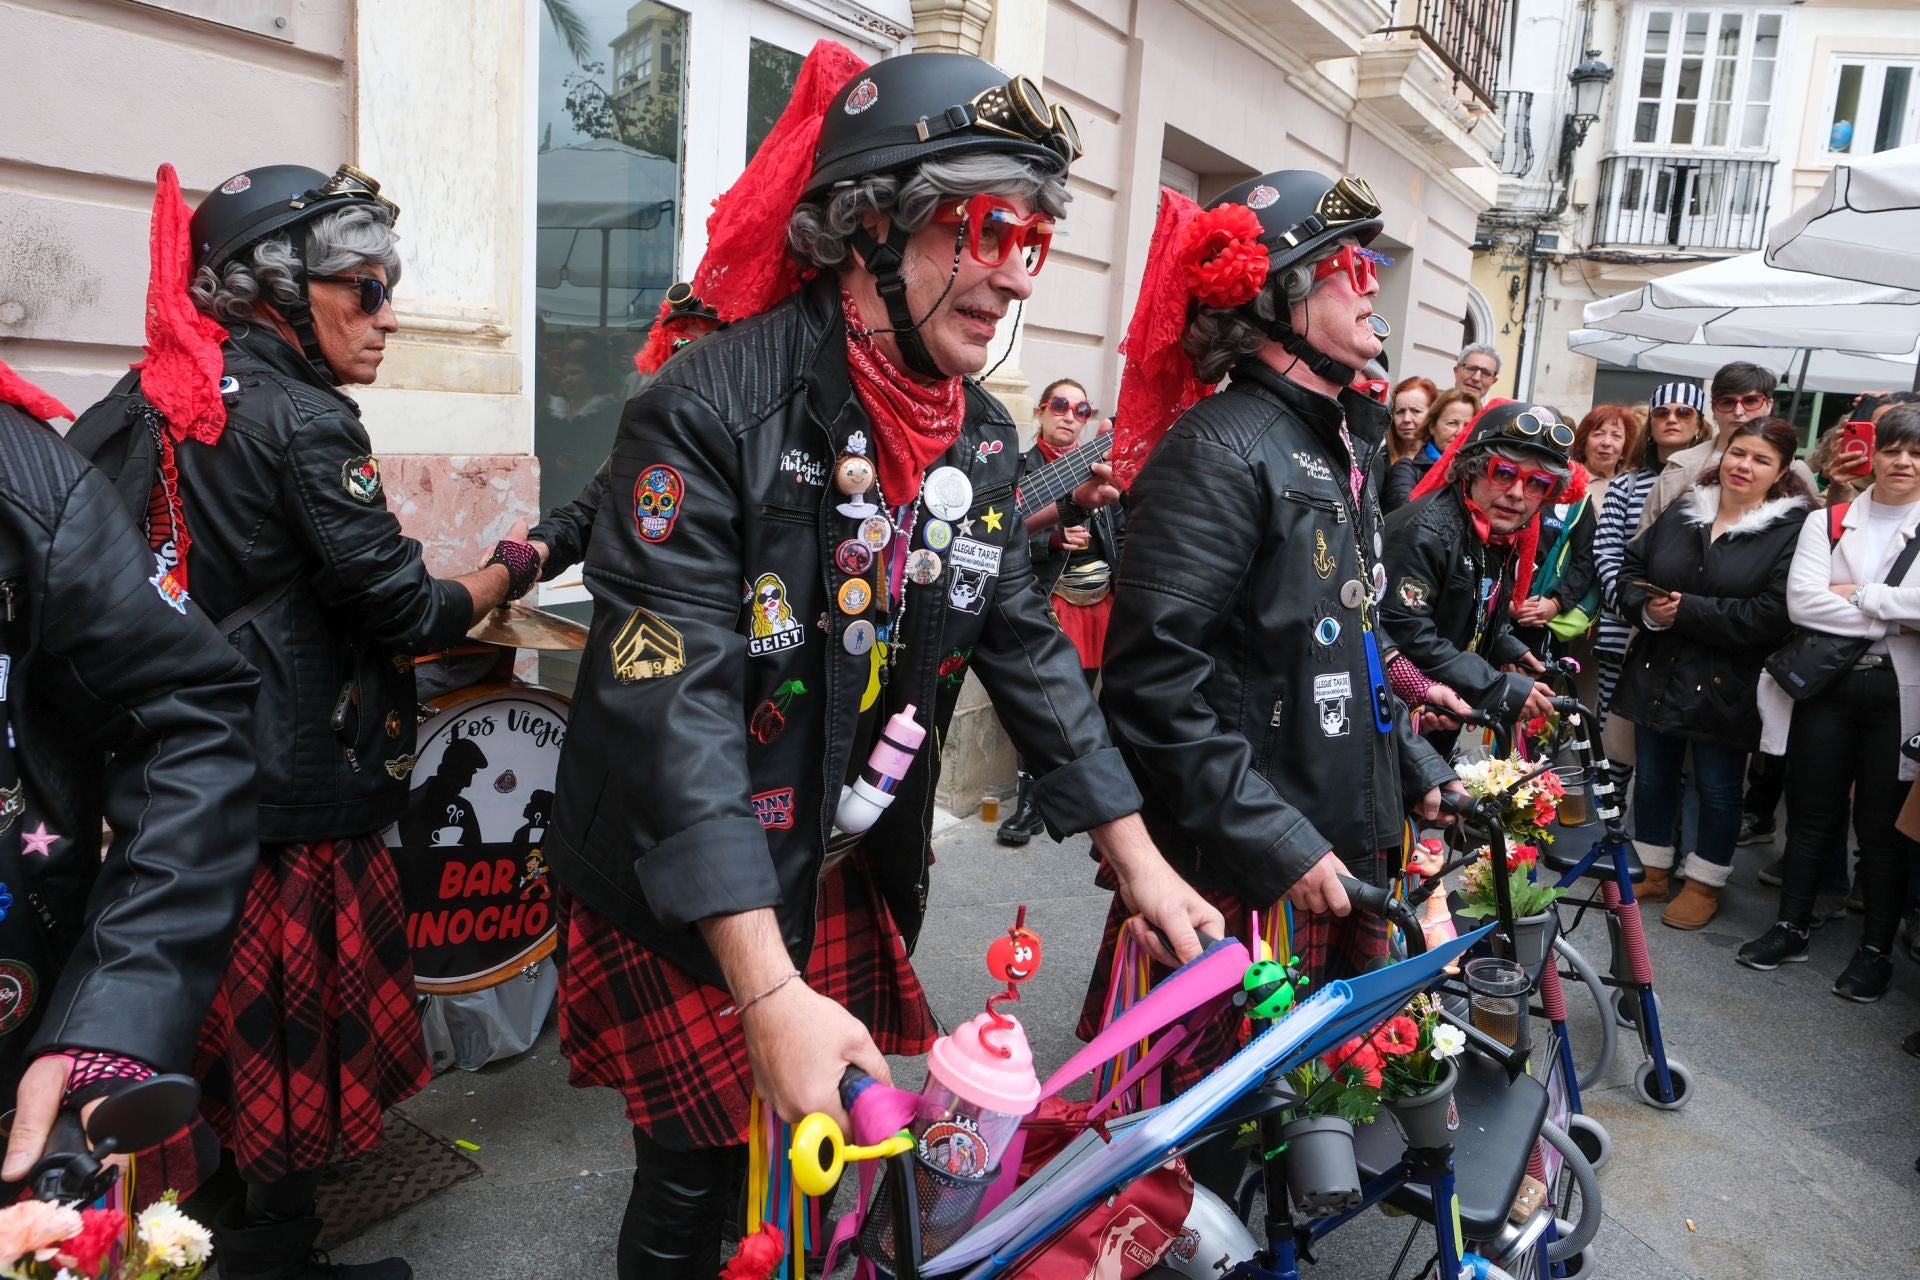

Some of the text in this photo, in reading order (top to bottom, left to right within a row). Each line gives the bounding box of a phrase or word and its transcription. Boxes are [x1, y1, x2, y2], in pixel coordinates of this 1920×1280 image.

[953, 542, 999, 562] LLEGUÉ TARDE
[750, 629, 800, 654] GEIST
[442, 716, 498, 745] Los
[439, 859, 516, 899] BAR
[406, 902, 549, 948] INOCHO
[955, 1115, 979, 1132] LAS
